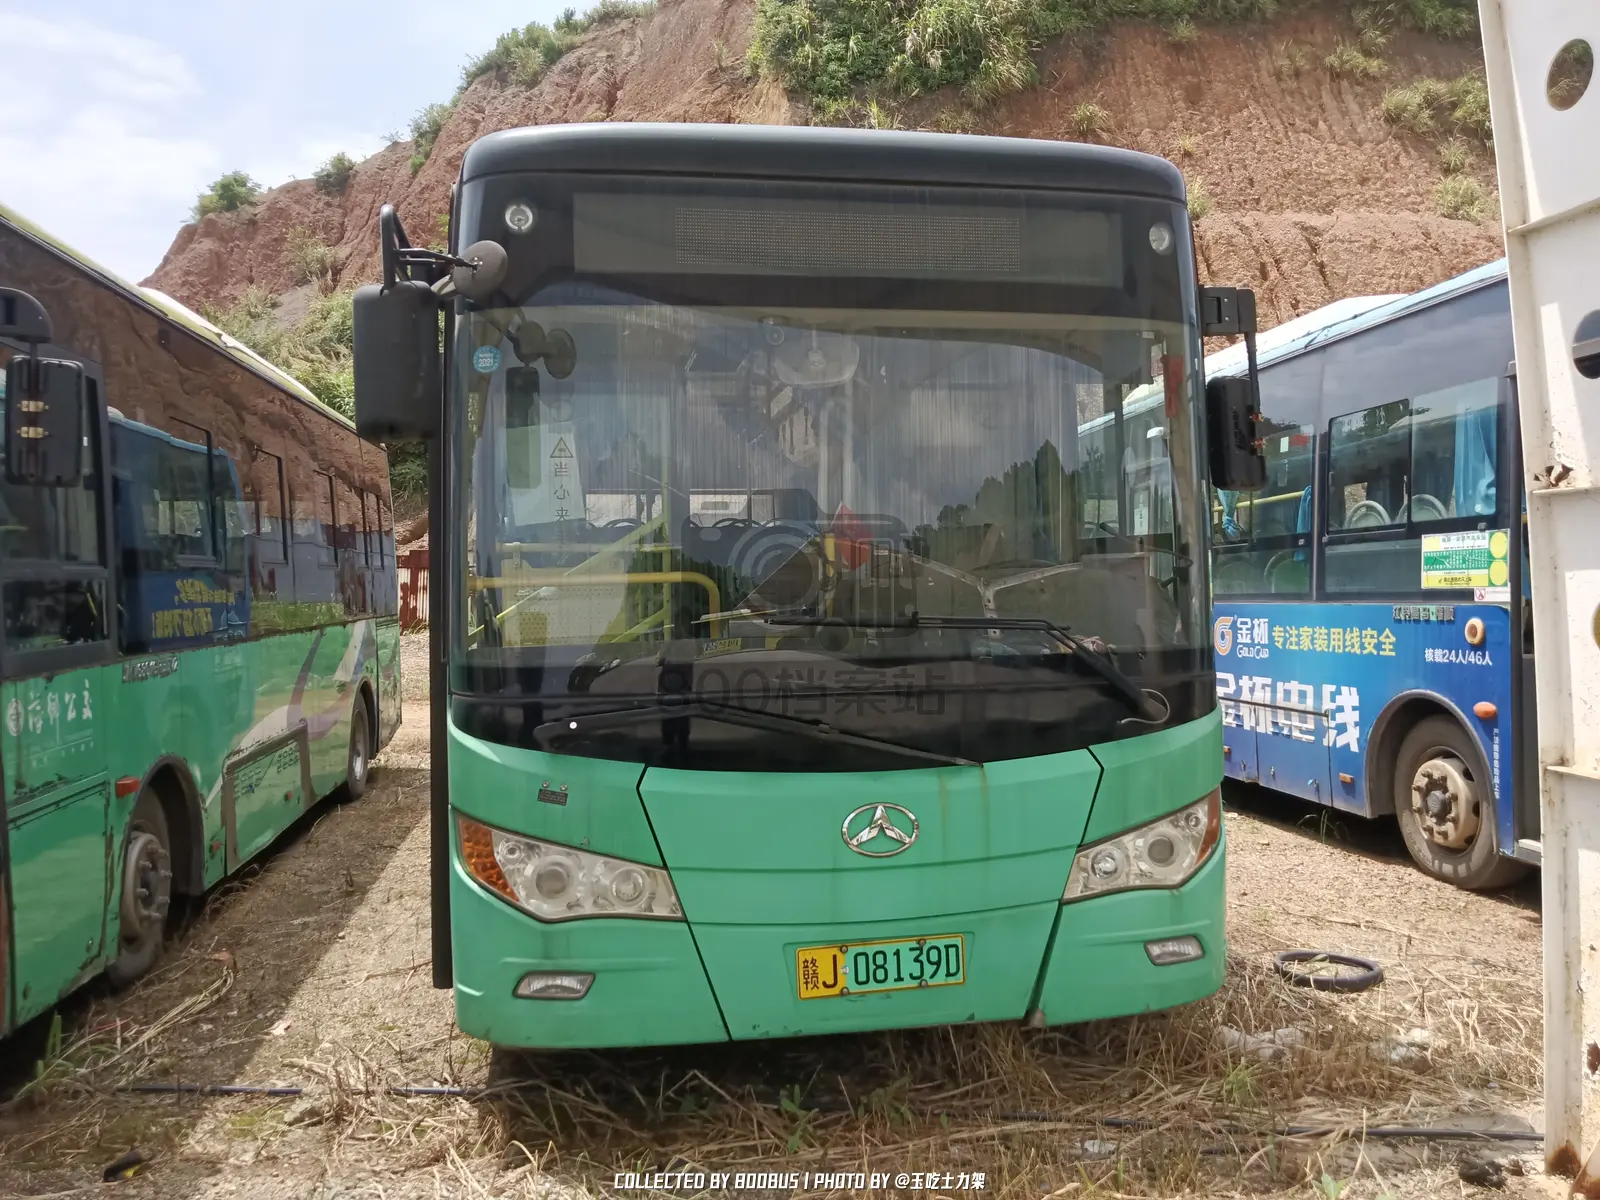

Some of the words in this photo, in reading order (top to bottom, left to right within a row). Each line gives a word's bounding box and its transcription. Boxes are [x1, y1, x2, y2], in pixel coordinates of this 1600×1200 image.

[1236, 617, 1269, 645] 金杯
[1272, 624, 1397, 657] 专注家装用线安全
[1424, 647, 1493, 667] 核载24人/46人
